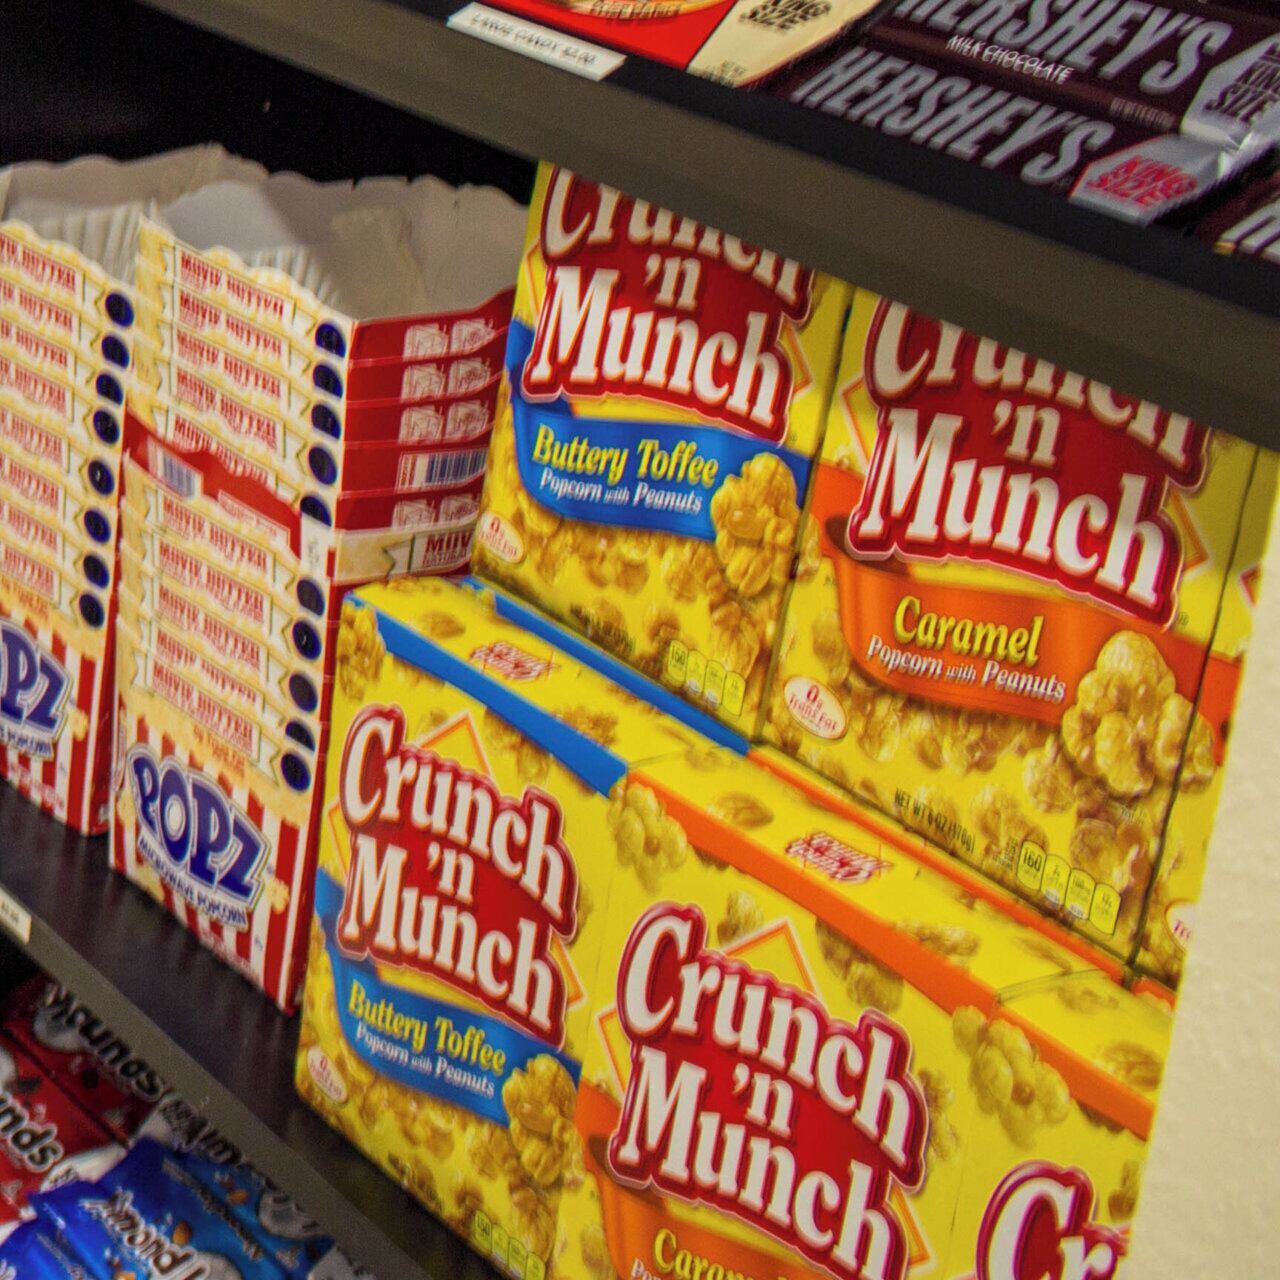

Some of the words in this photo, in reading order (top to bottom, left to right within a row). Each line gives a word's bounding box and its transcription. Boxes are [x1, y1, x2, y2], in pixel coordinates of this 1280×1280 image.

[946, 34, 983, 58] MILK
[980, 44, 1074, 85] CHOCOLATE
[789, 46, 1117, 185] HERSHEY'S
[532, 265, 778, 430] Munch
[534, 423, 628, 486] Buttery
[636, 439, 719, 488] Toffee
[540, 468, 602, 509] Popcorn
[633, 481, 703, 516] Peanuts
[860, 409, 1167, 607] Munch
[866, 634, 944, 675] Popcorn
[945, 661, 977, 682] with
[981, 659, 1068, 703] Peanuts
[894, 595, 1045, 668] Caramel
[132, 755, 262, 899] POPZ
[344, 717, 566, 919] Crunch
[894, 787, 911, 809] NET
[1023, 847, 1043, 872] 160
[196, 890, 247, 924] POPCORN
[344, 834, 553, 1034] Munch
[348, 978, 428, 1053] Buttery
[434, 1016, 506, 1078] Toffee
[356, 1021, 409, 1065] Popcorn
[435, 1055, 495, 1099] Peanuts
[625, 915, 910, 1167] Crunch
[620, 1044, 891, 1280] Munch
[654, 1228, 788, 1280] Cara
